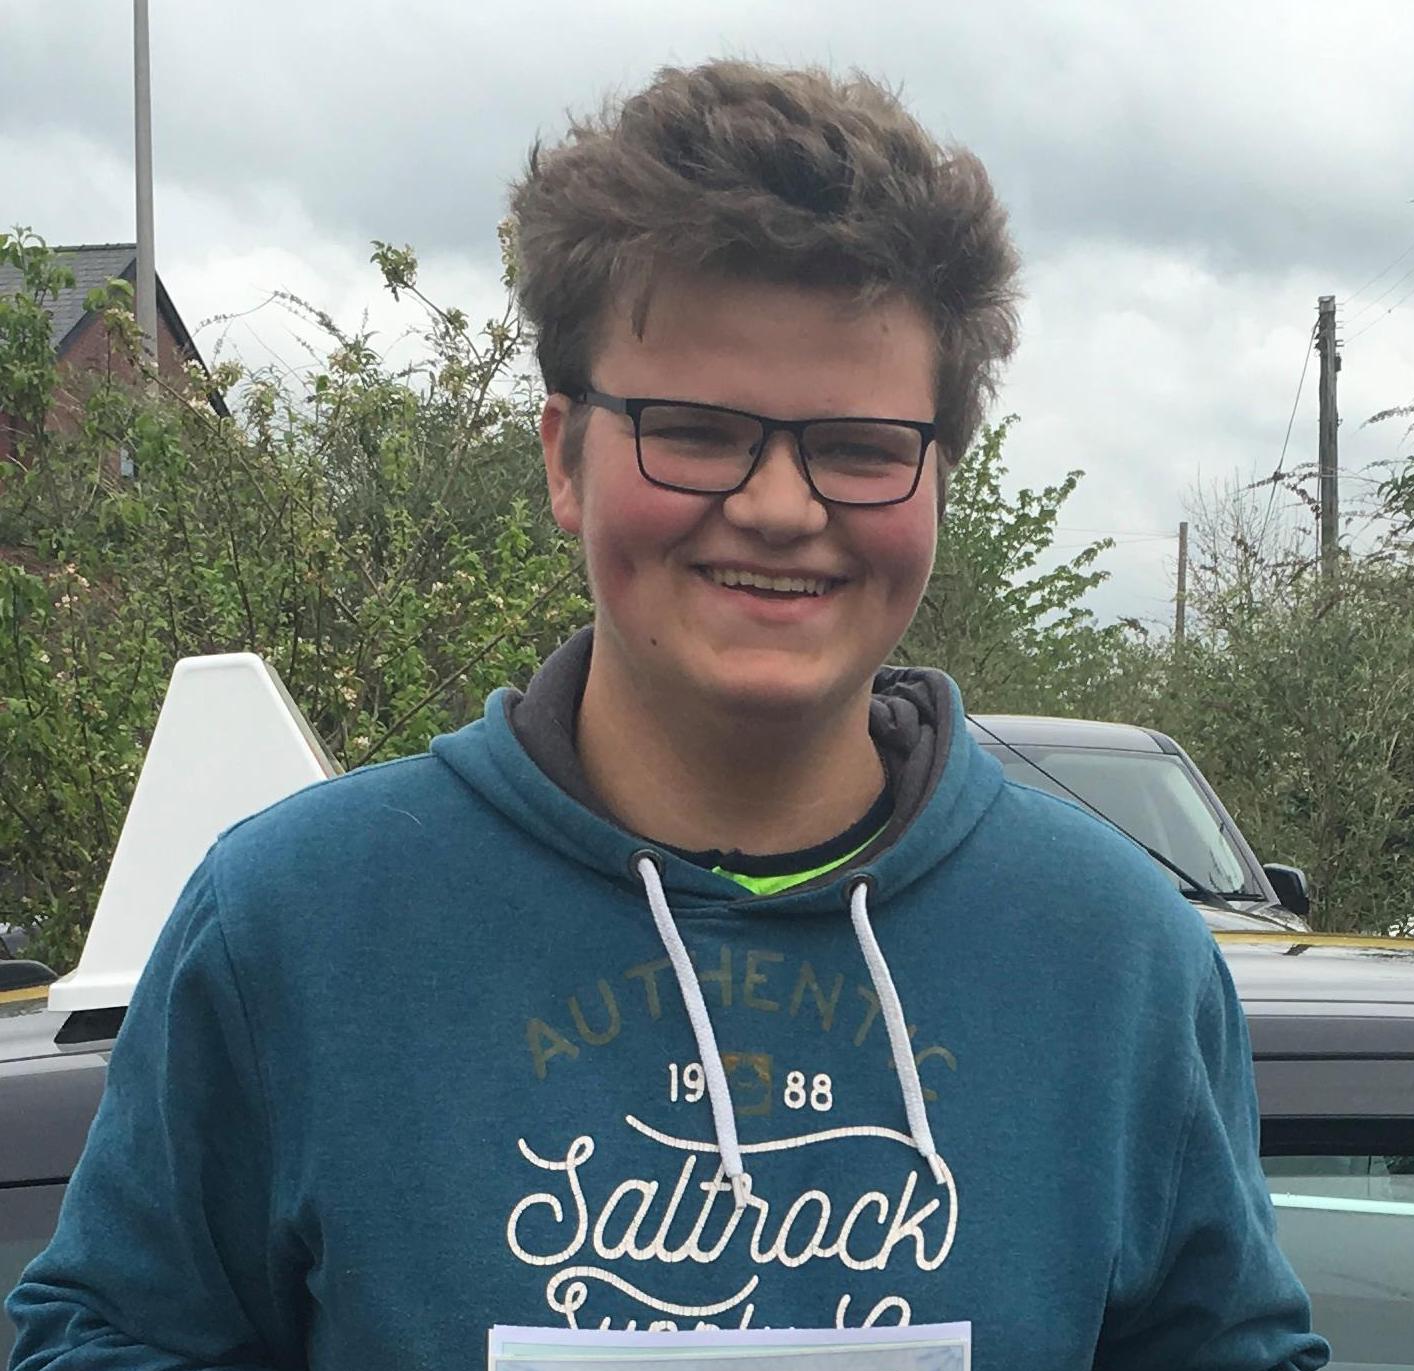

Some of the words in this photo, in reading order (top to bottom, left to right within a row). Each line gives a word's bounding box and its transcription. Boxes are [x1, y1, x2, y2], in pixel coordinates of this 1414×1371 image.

[526, 943, 957, 1101] AUTHENTC
[668, 1063, 705, 1103] 19
[784, 1070, 833, 1111] 88
[506, 1117, 958, 1271] Saltrock
